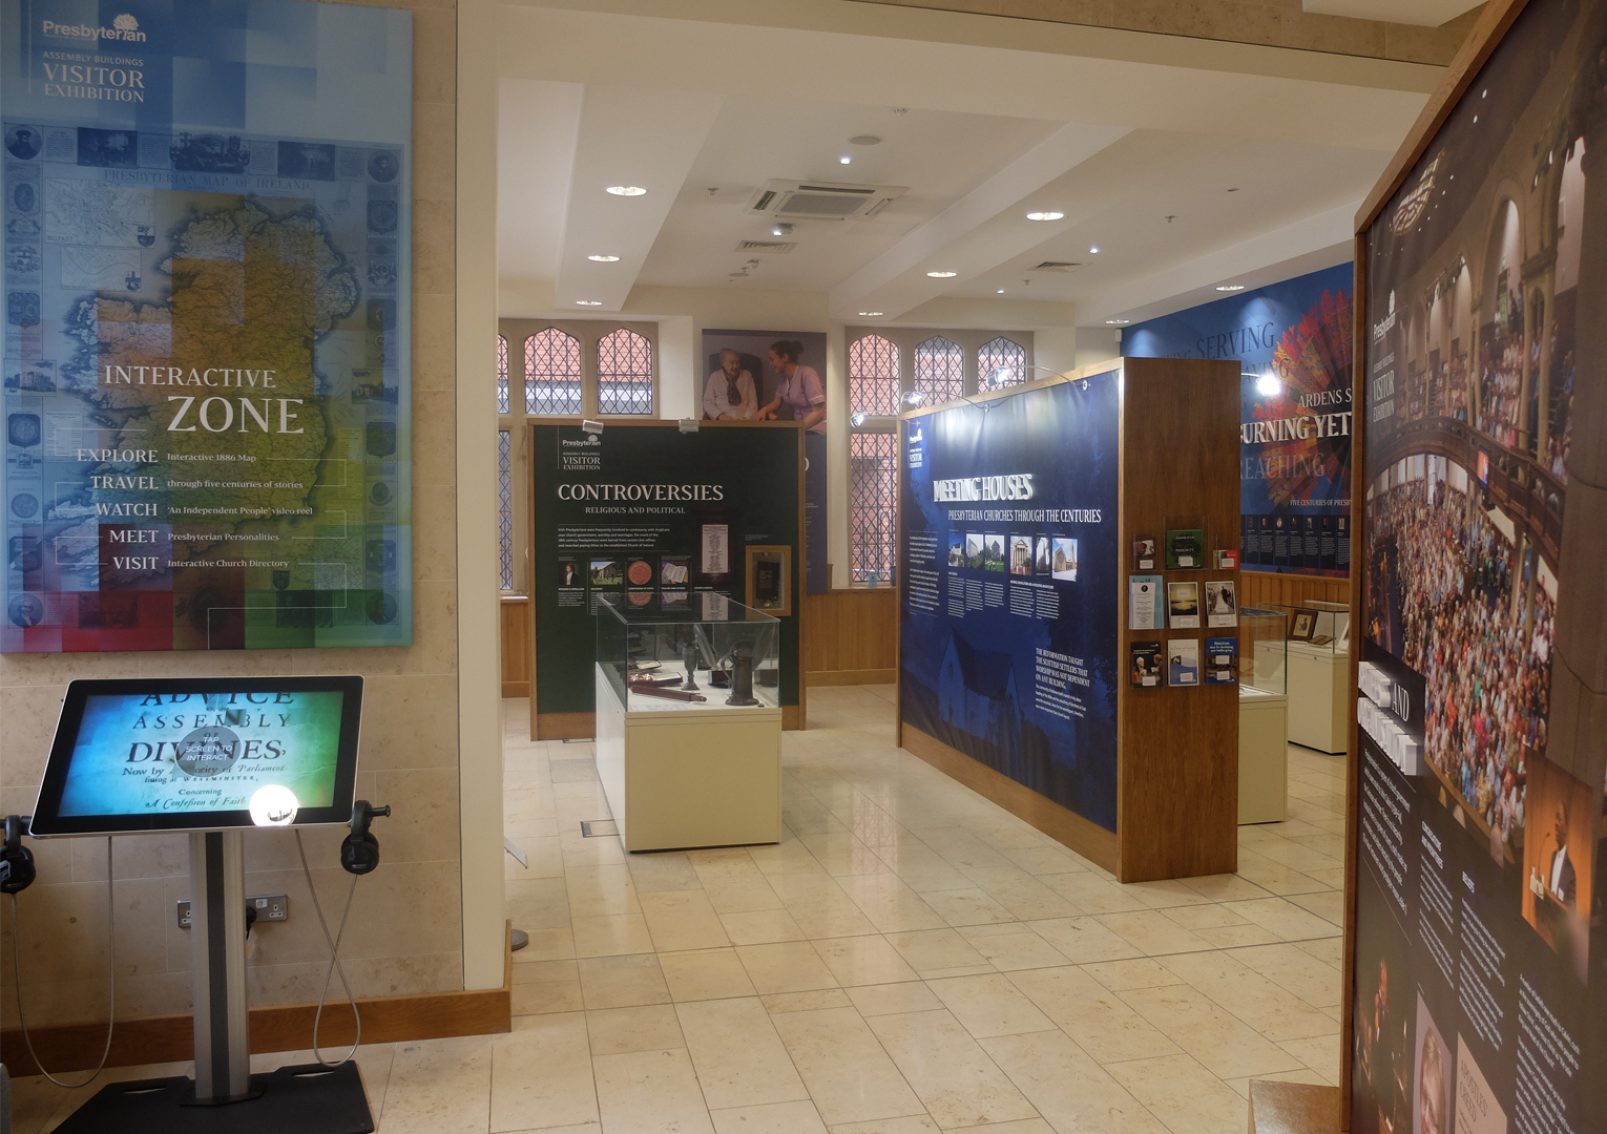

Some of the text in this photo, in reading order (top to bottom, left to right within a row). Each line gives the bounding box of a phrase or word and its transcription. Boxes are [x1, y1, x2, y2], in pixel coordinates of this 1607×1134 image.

[42, 20, 146, 42] Presbyterian
[42, 51, 144, 67] ASSEMBLY BUILDINGS
[42, 62, 145, 88] VISITOR
[44, 83, 144, 103] EXHIBITION
[1196, 321, 1275, 360] SERVING
[104, 364, 277, 388] INTERACTIVE
[1297, 389, 1343, 408] ARDENS
[167, 395, 305, 434] ZONE
[1240, 411, 1352, 444] URNING YET
[76, 448, 257, 463] EXPLORE Interactive 1886 Map
[563, 456, 601, 464] VISITOR
[1240, 452, 1326, 480] EACHING
[90, 476, 304, 489] TRAVEL through five centuries of stories
[932, 473, 1034, 502] MEETING HOUSES
[557, 483, 725, 501] CONTROVERSIES
[95, 502, 158, 517] WATCH
[183, 506, 238, 515] Independent
[272, 506, 295, 515] video
[296, 506, 313, 515] reel
[585, 506, 686, 514] RELIGIOUS AND POLITICAL
[948, 508, 1102, 524] PRESBYTERIAN CHURCHES THROUGH THE CENTURIES
[109, 529, 280, 544] MEET Presbyterian Personalities
[113, 556, 289, 570] VISIT Interactive Church Directory
[1391, 682, 1410, 722] AND
[221, 744, 233, 752] TO
[186, 753, 229, 762] INTERACT
[122, 767, 147, 776] Now
[151, 767, 164, 777] by
[178, 788, 222, 796] Concerning
[208, 797, 219, 805] of
